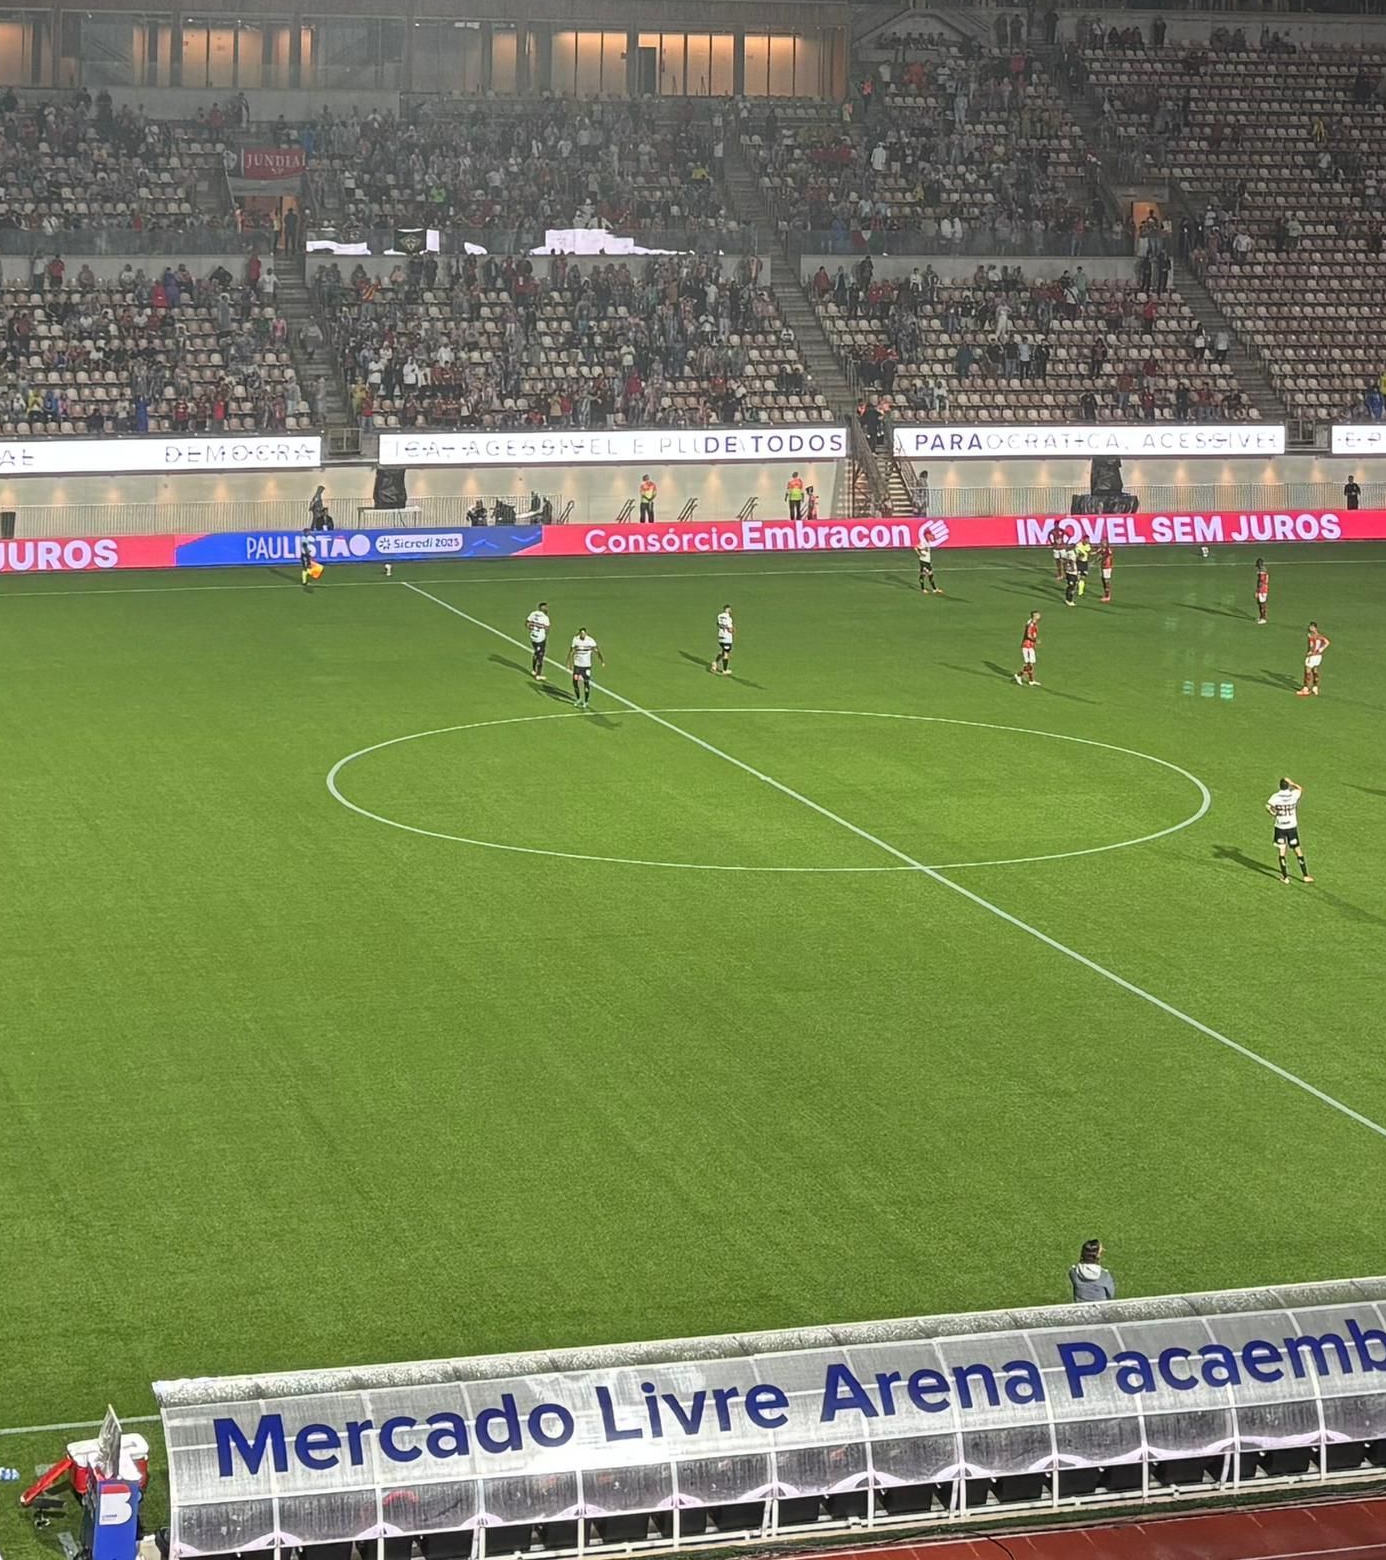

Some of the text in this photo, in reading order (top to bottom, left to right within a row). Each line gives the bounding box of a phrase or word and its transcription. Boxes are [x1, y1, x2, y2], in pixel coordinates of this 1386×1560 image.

[750, 434, 843, 452] TODOS
[915, 433, 983, 452] PARA
[585, 519, 910, 554] Consórcio Embracon
[1151, 515, 1223, 543] SEM
[1230, 512, 1342, 541] JUROS
[393, 536, 433, 549] Sicredi
[213, 1389, 575, 1478] Mercado
[594, 1379, 789, 1442] Livre
[820, 1352, 1045, 1423] Arena
